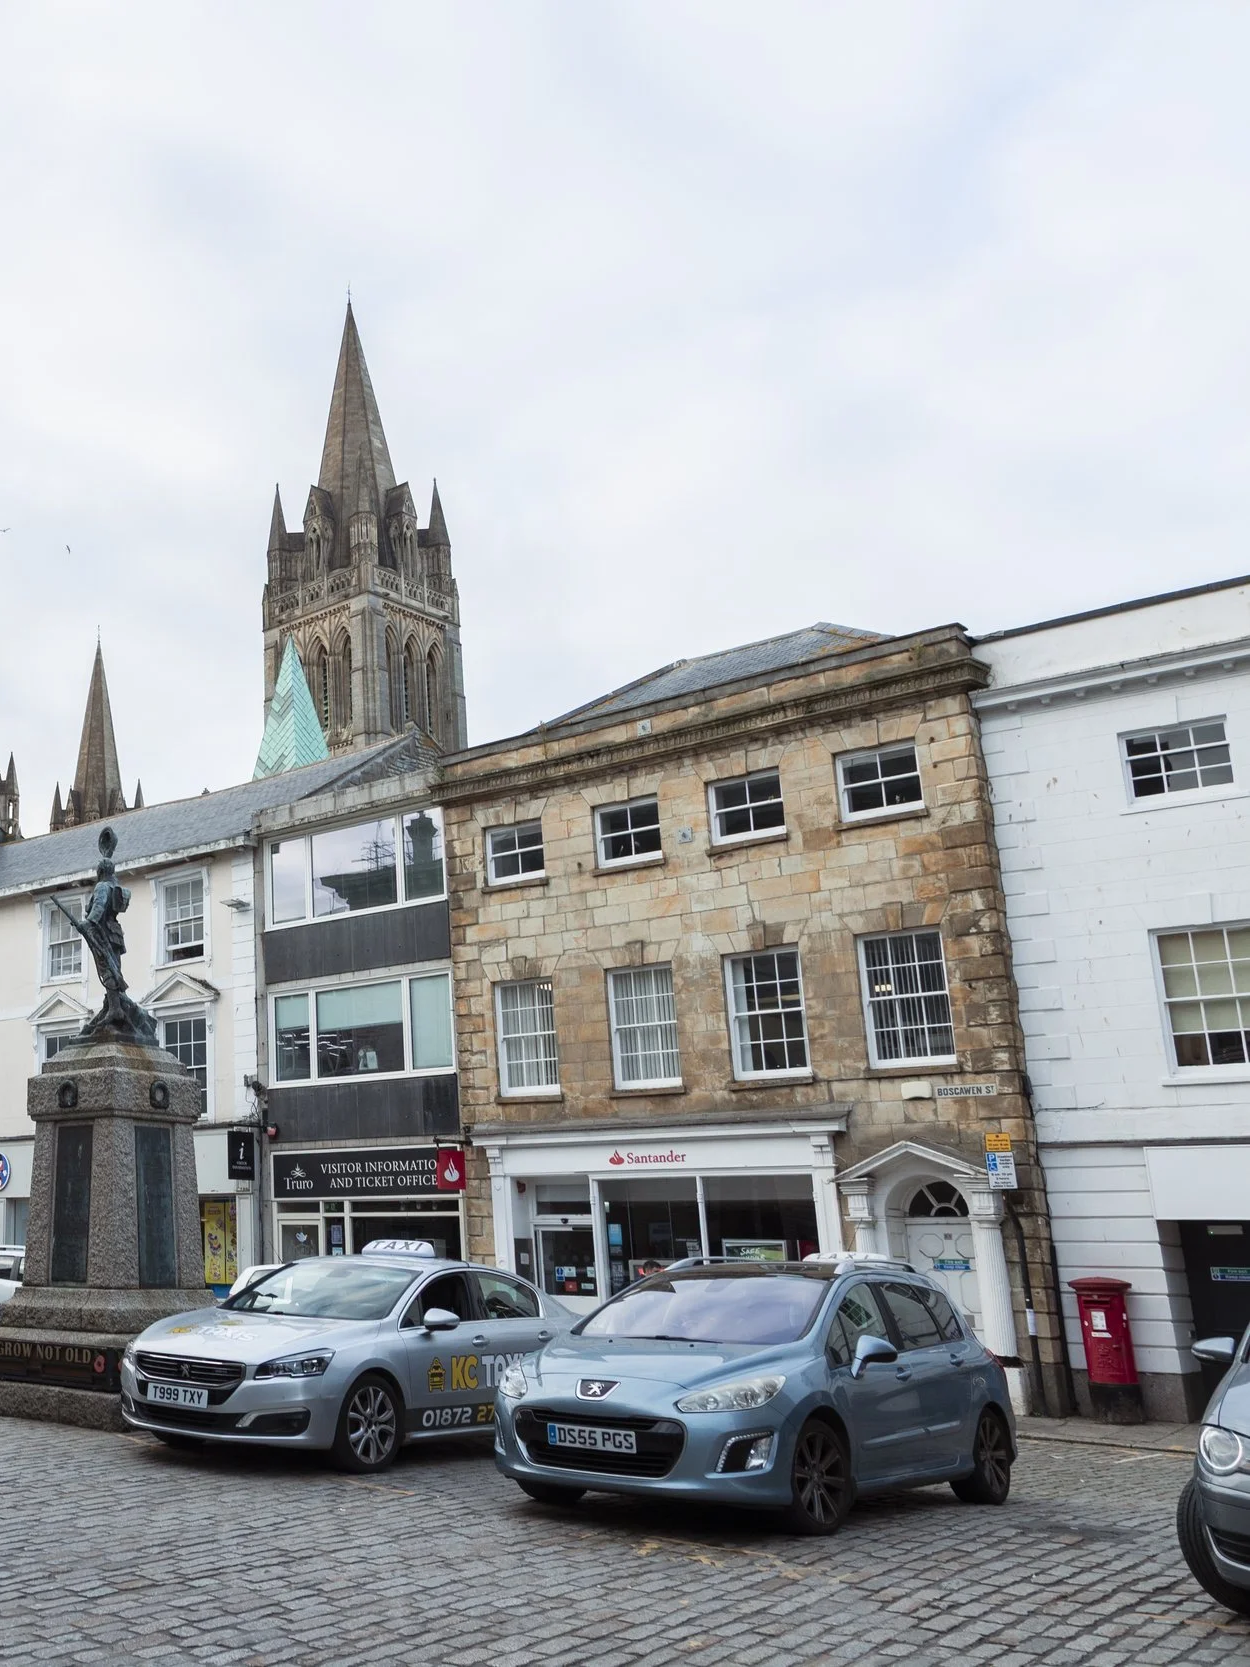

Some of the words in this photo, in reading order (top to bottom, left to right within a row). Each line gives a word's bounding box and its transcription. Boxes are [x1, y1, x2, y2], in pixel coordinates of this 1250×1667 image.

[937, 1086, 982, 1096] BOSCAWEN
[627, 1149, 687, 1164] Santander
[988, 1154, 995, 1162] P
[320, 1162, 362, 1174] VISITOR
[365, 1159, 438, 1173] INFORMATIO
[284, 1177, 314, 1190] Truro
[330, 1177, 353, 1189] AND
[355, 1176, 395, 1188] TICKET
[397, 1174, 438, 1186] OFFICE
[372, 1240, 425, 1251] TAXI
[36, 1345, 62, 1361] NOT
[65, 1348, 92, 1364] OLD
[451, 1355, 479, 1390] KC
[152, 1385, 179, 1401] T999
[182, 1389, 204, 1404] TXY
[422, 1406, 472, 1427] 01872
[476, 1404, 495, 1423] 27
[557, 1427, 597, 1446] DS55
[601, 1431, 634, 1450] PGS
